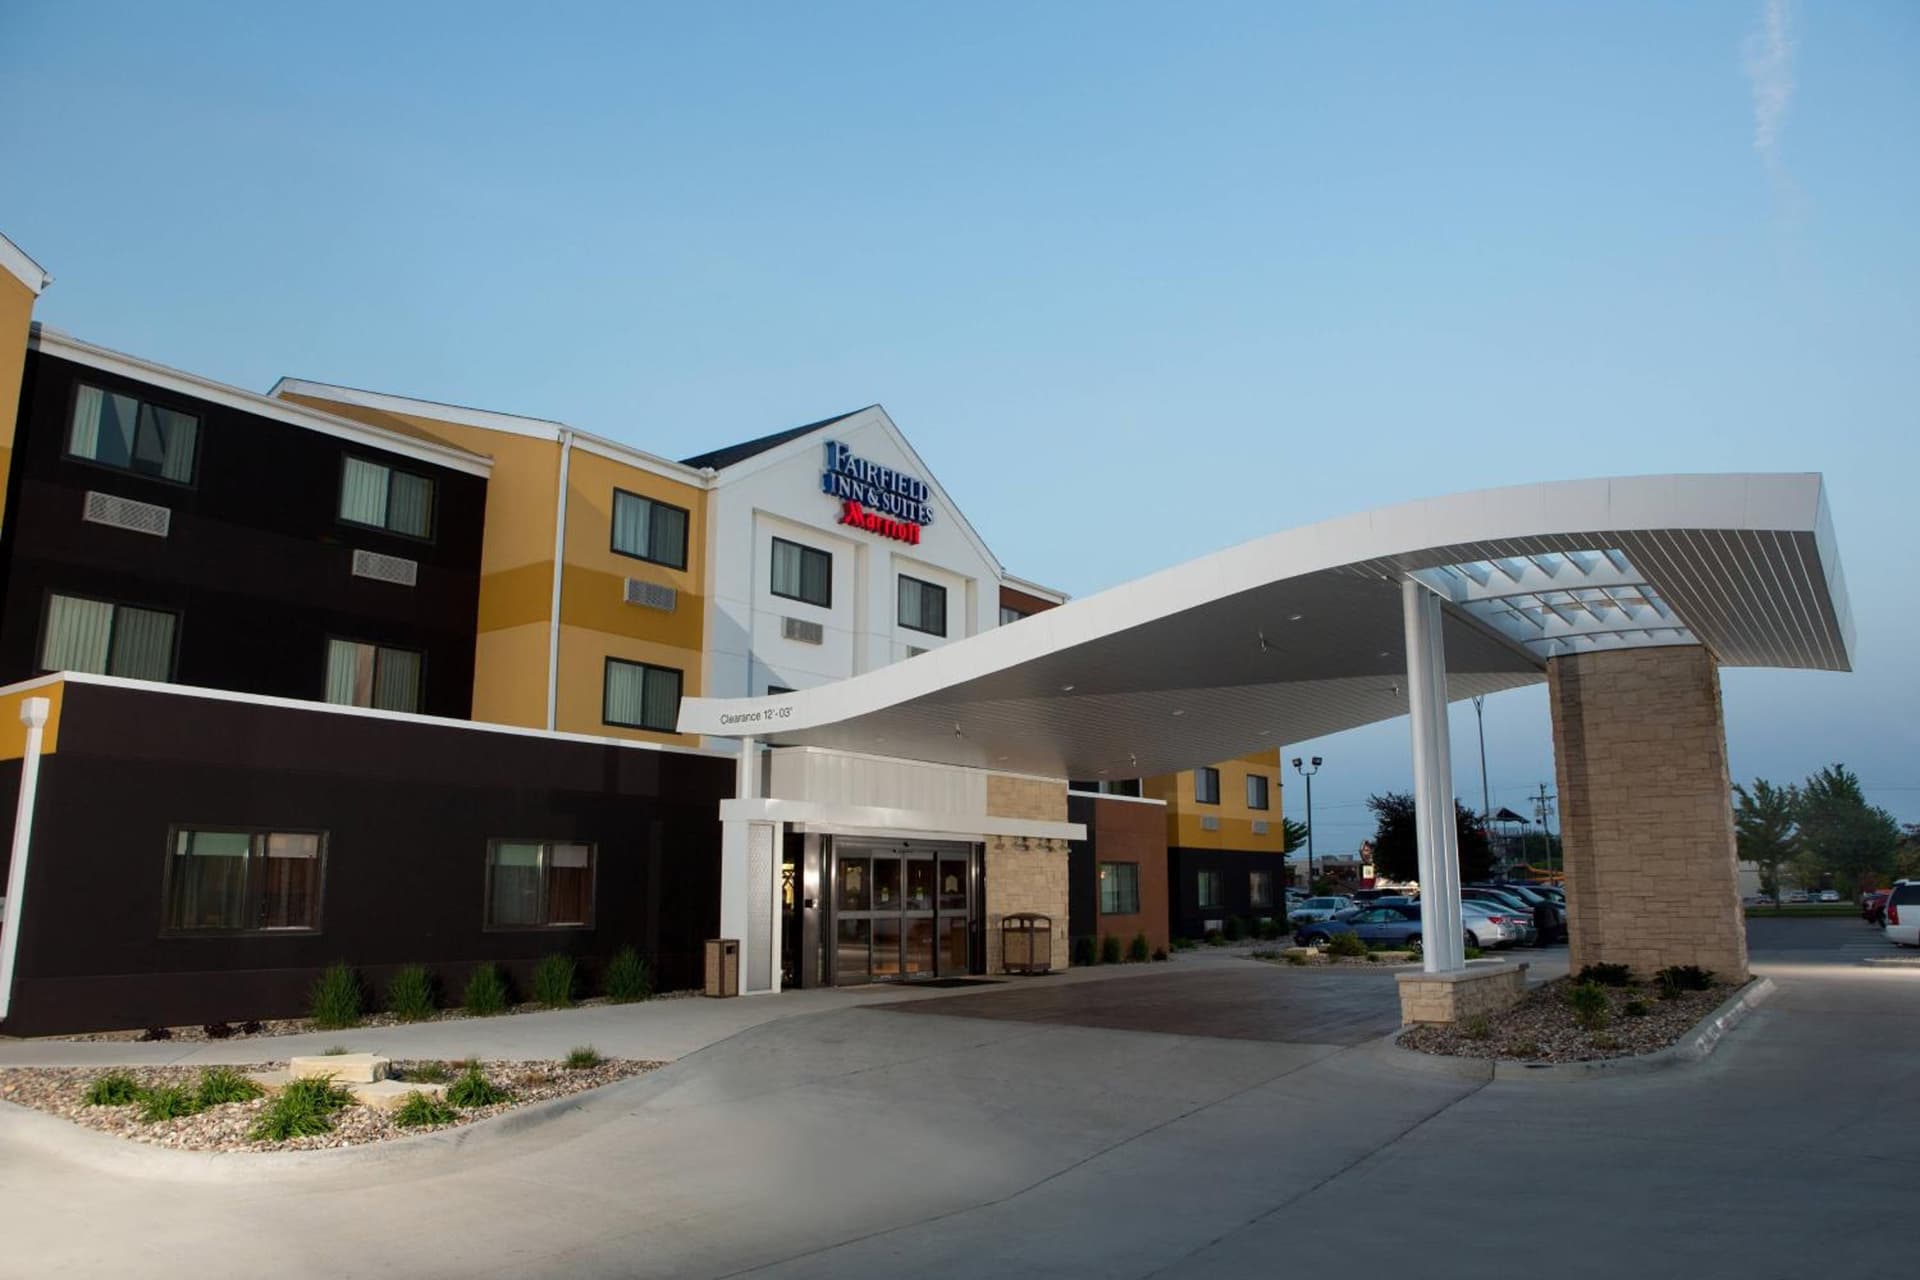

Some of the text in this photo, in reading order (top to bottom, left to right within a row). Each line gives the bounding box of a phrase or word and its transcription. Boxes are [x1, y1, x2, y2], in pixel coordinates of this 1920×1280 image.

[826, 440, 929, 503] FAIRFIELD
[838, 500, 920, 545] Marriott
[720, 713, 761, 725] Clearance
